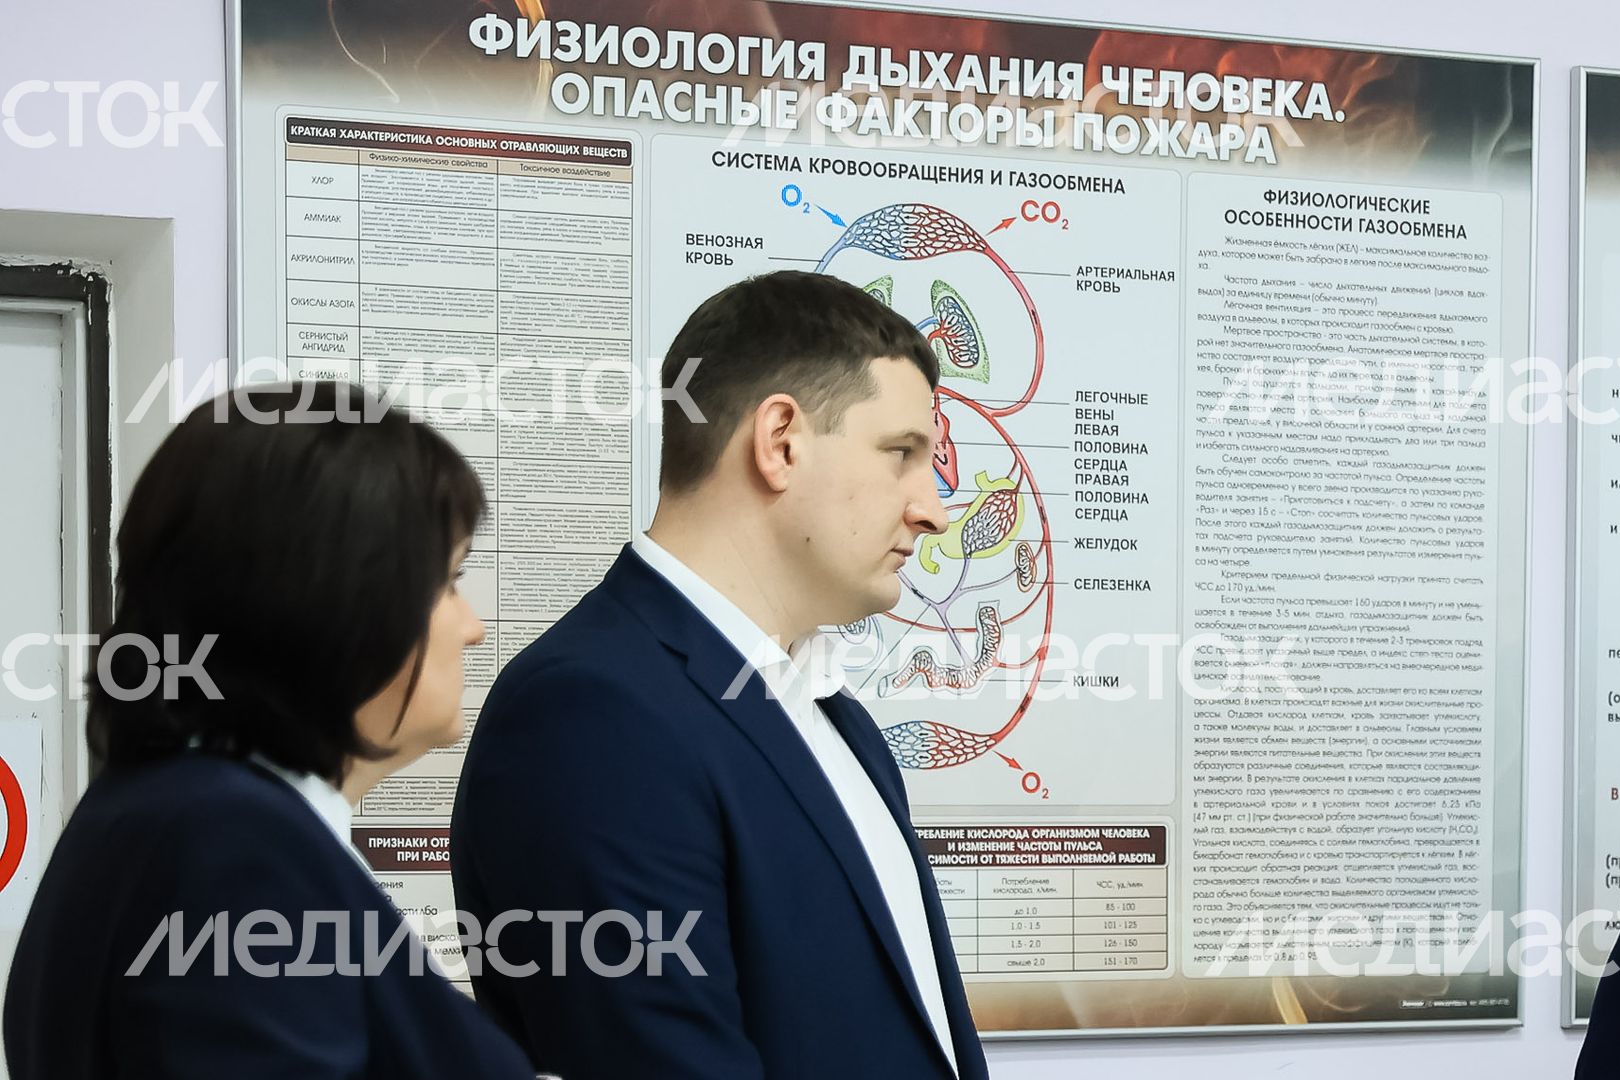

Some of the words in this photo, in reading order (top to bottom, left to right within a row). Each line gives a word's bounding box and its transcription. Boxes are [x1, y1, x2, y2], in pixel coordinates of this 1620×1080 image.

[468, 12, 827, 82] ФИЗИОЛОГИЯ
[842, 45, 1085, 101] ДЫХАНИЯ
[1101, 61, 1346, 123] ЧЕЛОВЕКА.
[550, 73, 800, 129] ОПАСНЫЕ
[814, 94, 1058, 149] ФАКТОРЫ
[1072, 109, 1278, 165] ПОЖАРА
[290, 125, 337, 139] КРАТКАЯ
[339, 128, 433, 146] ХАРАКТЕРИСТИКА
[436, 135, 497, 150] ОСНОВНЫХ
[500, 139, 580, 155] ОТРАВЛЯЮЩИХ
[582, 145, 628, 159] ВЕЩЕСТВ
[712, 150, 802, 173] СИСТЕМА
[809, 157, 984, 184] КРОВООБРАЩЕНИЯ
[991, 170, 1002, 186] И
[1009, 171, 1125, 194] ГАЗООБМЕНА
[311, 176, 334, 186] ХЛОР
[1264, 189, 1430, 215] ФИЗИОЛОГИЧЕСКИЕ
[304, 213, 342, 224] АММИАК
[1224, 209, 1352, 232] ОСОБЕННОСТИ
[1359, 218, 1467, 240] ГАЗООБМЕНА
[686, 233, 763, 250] ВЕНОЗНАЯ
[290, 253, 355, 266] АКРИЛОНИТРИЛ
[686, 251, 734, 266] КРОВЬ
[1076, 265, 1175, 282] АРТЕРИАЛЬНАЯ
[1076, 279, 1120, 293] КРОВЬ
[290, 297, 327, 309] ОКИСЛЫ
[329, 298, 355, 310] АЗОТА
[298, 331, 349, 343] СЕРНИСТЫЙ
[302, 342, 346, 355] АНГИДРИД
[1075, 390, 1148, 405] ЛЕГОЧНЫЕ
[1075, 408, 1114, 421] ВЕНЫ
[1074, 423, 1119, 437] ЛЕВАЯ
[1074, 440, 1148, 455] ПОЛОВИНА
[1074, 458, 1128, 475] СЕРДЦА
[1075, 473, 1129, 487] ПРАВАЯ
[1075, 490, 1149, 504] ПОЛОВИНА
[1075, 508, 1128, 523] СЕРДЦА
[1074, 537, 1138, 552] ЖЕЛУДОК
[1074, 578, 1151, 591] СЕЛЕЗЕНКА
[1074, 675, 1119, 688] КИШКИ
[915, 829, 965, 839] РЕБЛЕНИЕ
[967, 828, 1030, 840] КИСЛОРОДА
[1032, 828, 1100, 839] ОРГАНИЗМОМ
[1101, 828, 1150, 839] ЧЕЛОВЕКА
[368, 838, 428, 848] ПРИЗНАКИ
[431, 838, 450, 848] ОТР
[947, 842, 957, 852] И
[958, 841, 1015, 852] ИЗМЕНЕНИЕ
[1017, 841, 1062, 852] ЧАСТОТЫ
[1064, 841, 1103, 852] ПУЛЬСА
[397, 851, 419, 862] ПРИ
[422, 851, 450, 862] РАБО
[928, 854, 978, 865] СИМОСТИ
[980, 854, 995, 864] ОТ
[996, 854, 1040, 864] ТЯЖЕСТИ
[1041, 852, 1116, 865] ВЫПОЛНЯЕМОЙ
[1118, 853, 1156, 863] РАБОТЫ
